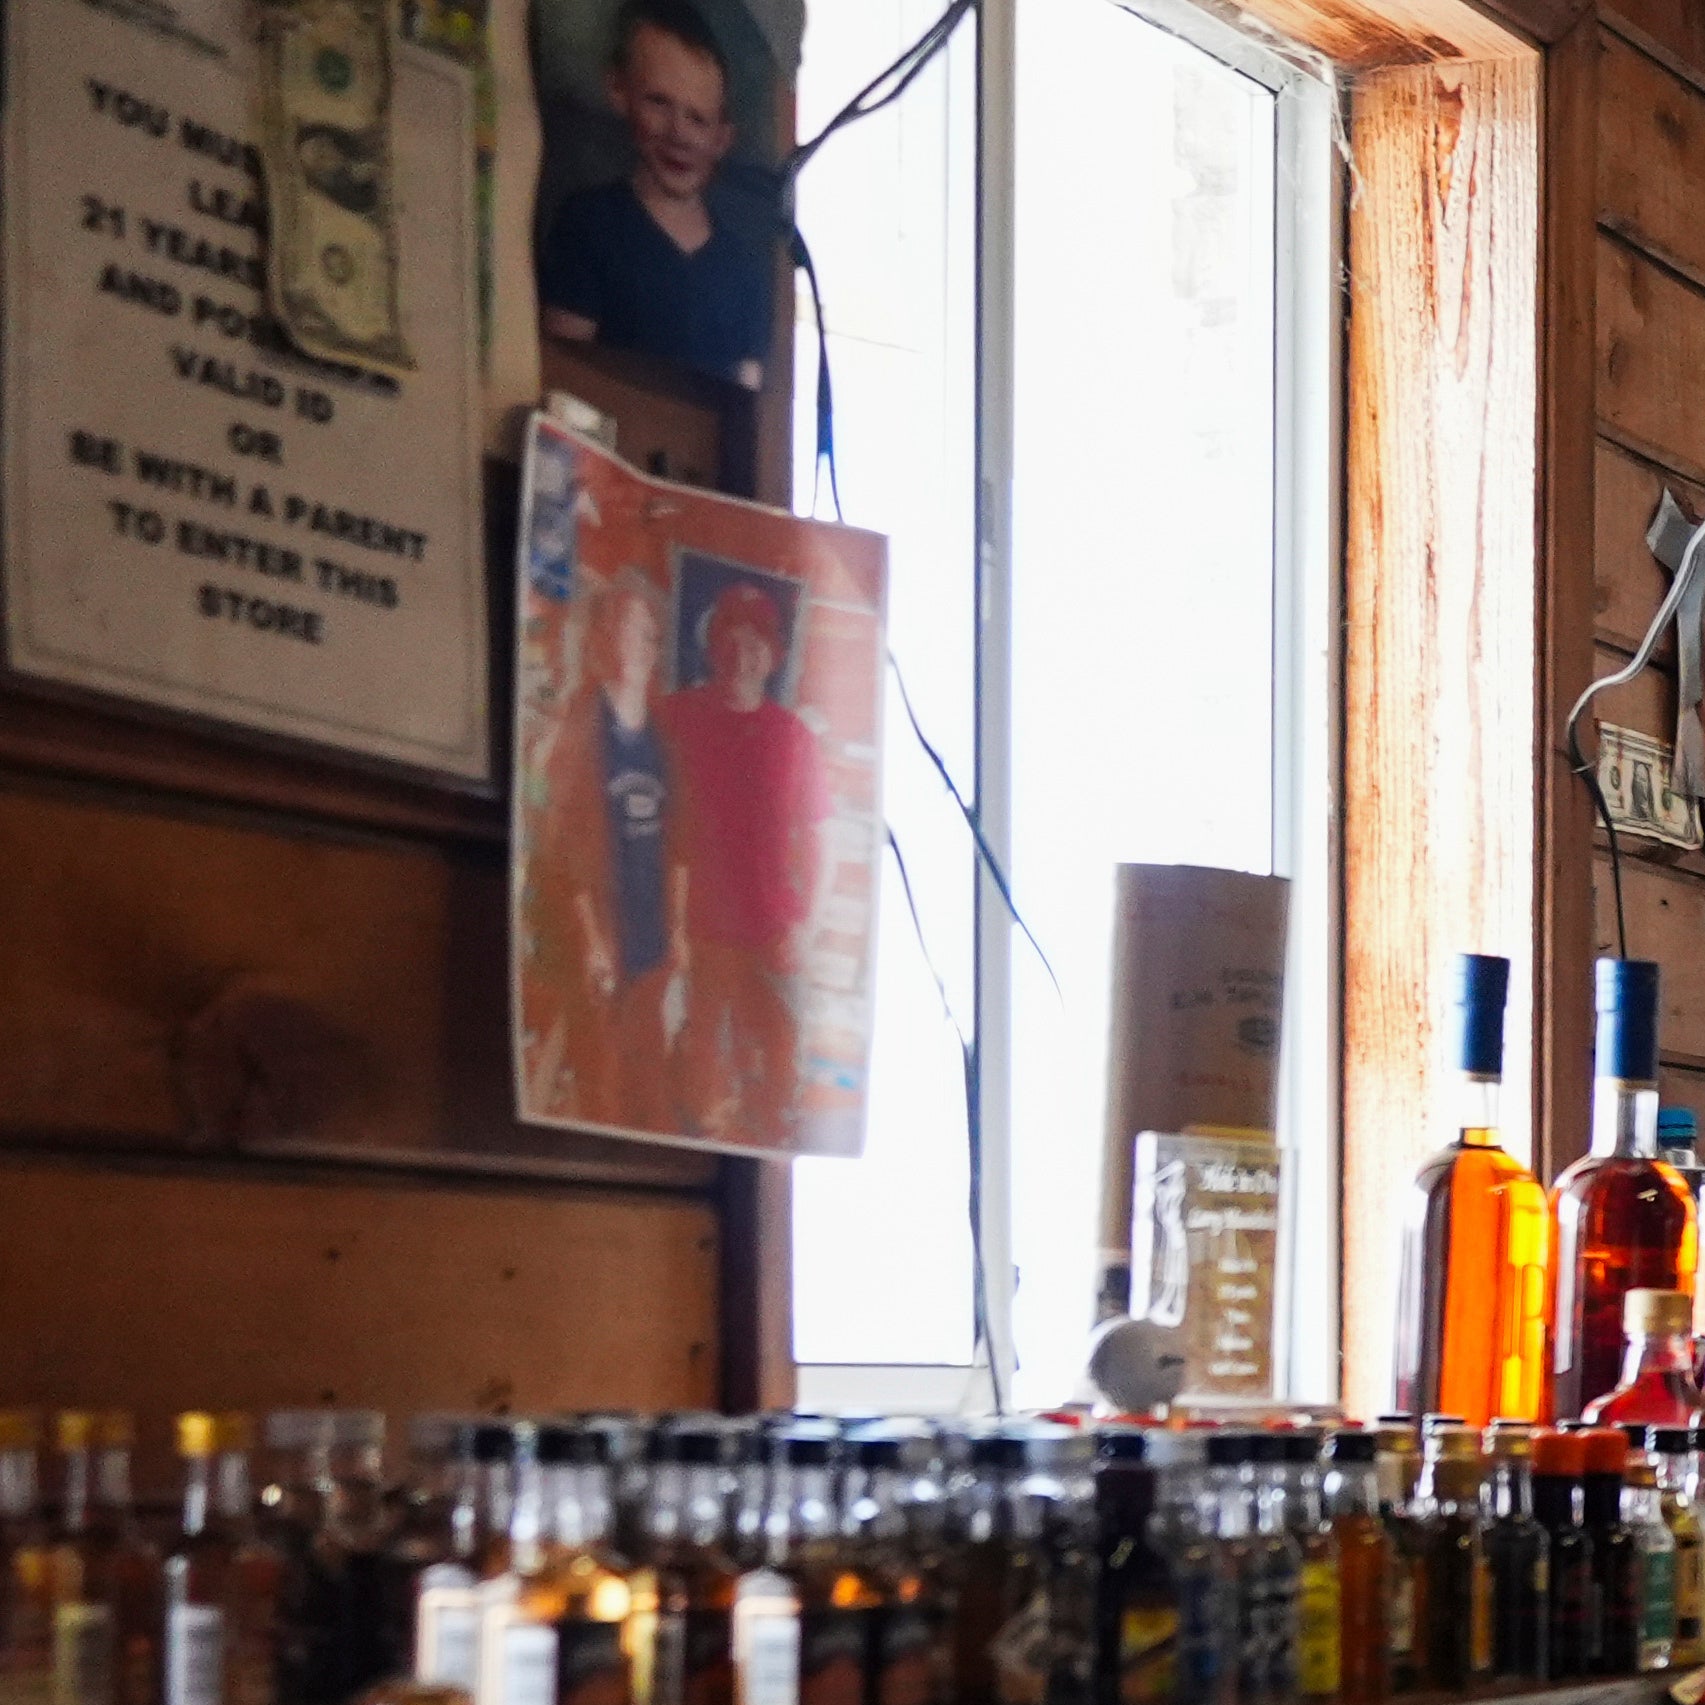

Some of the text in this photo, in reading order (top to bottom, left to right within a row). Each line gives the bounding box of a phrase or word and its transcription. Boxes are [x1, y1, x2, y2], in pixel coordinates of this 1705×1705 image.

[85, 75, 170, 138] YOU
[82, 196, 125, 238] 21
[99, 262, 182, 316] AND
[168, 345, 285, 407] VALID
[296, 387, 335, 424] ID
[228, 421, 285, 466] OR
[69, 429, 427, 562] BE WITH A PARENT
[107, 498, 399, 610] TO ENTER THIS
[198, 580, 325, 646] STORE
